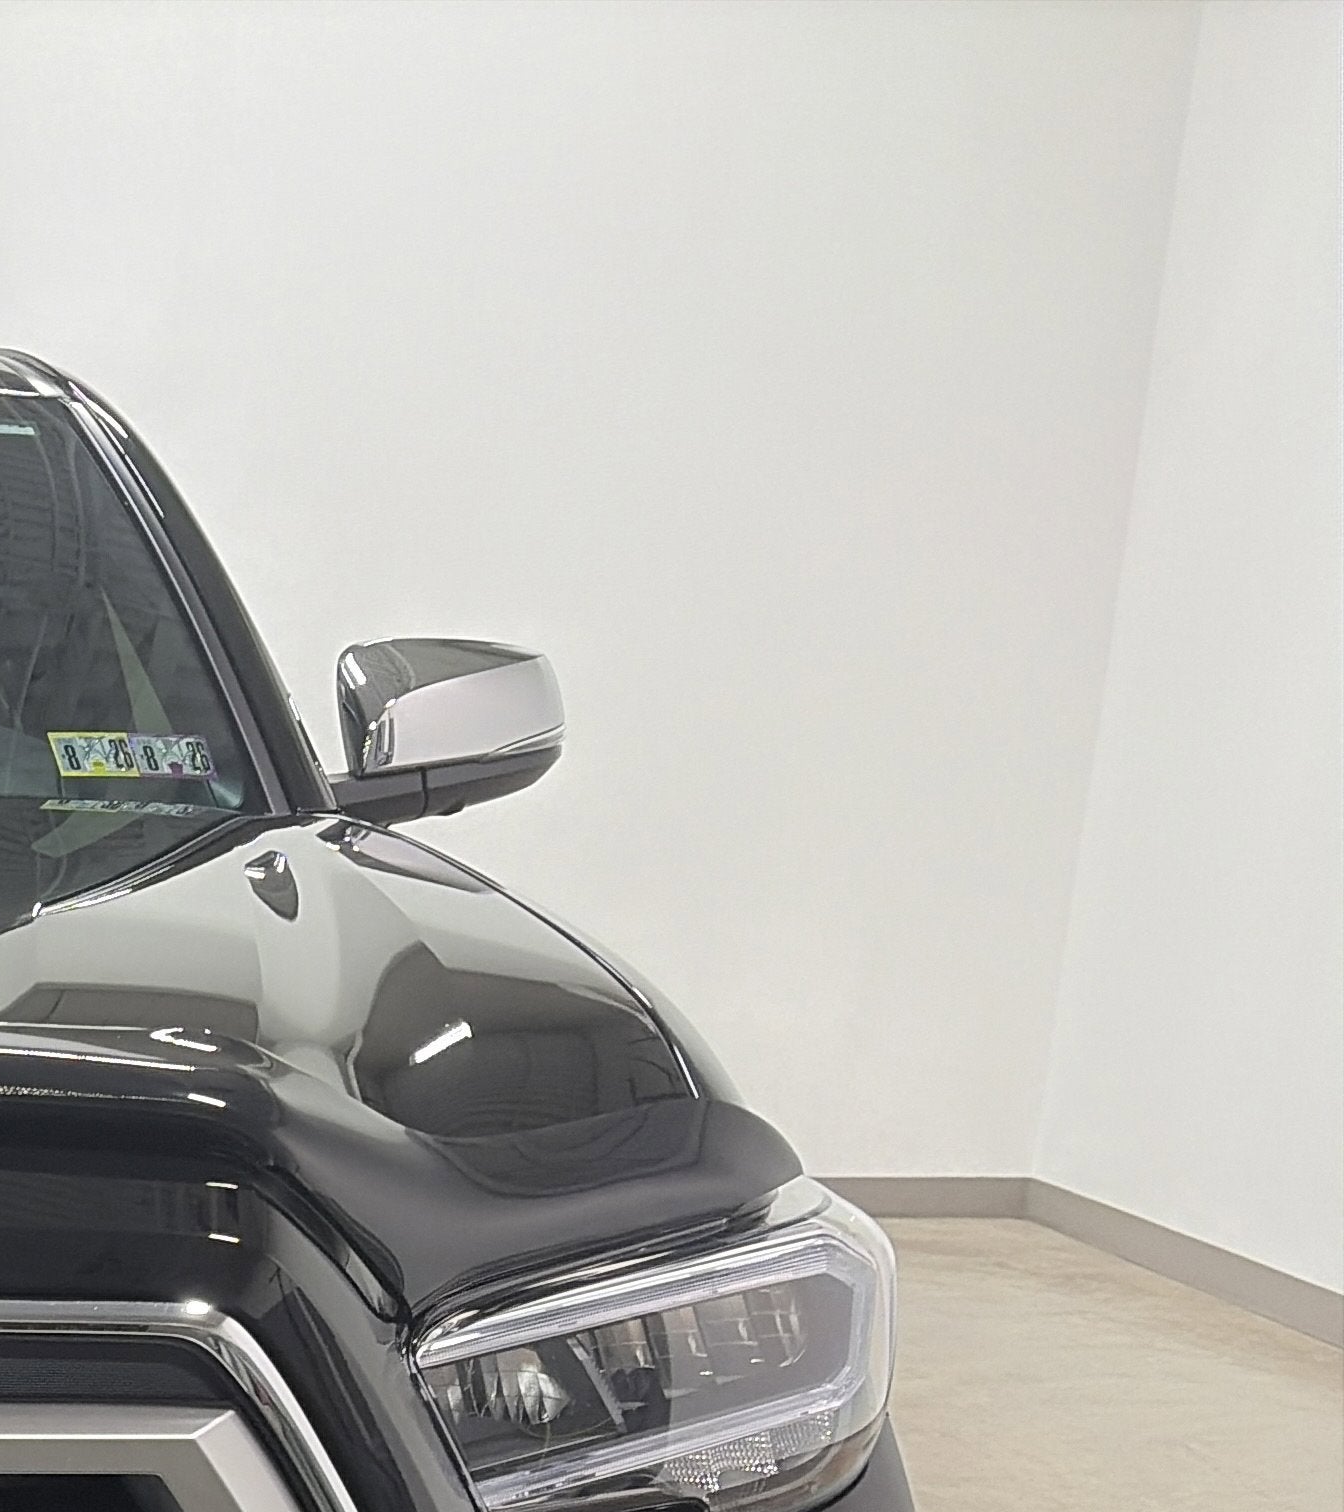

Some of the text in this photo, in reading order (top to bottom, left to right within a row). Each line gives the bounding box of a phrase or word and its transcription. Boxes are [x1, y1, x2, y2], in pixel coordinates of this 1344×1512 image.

[63, 739, 135, 771] 8 26
[142, 741, 211, 772] 8 26
